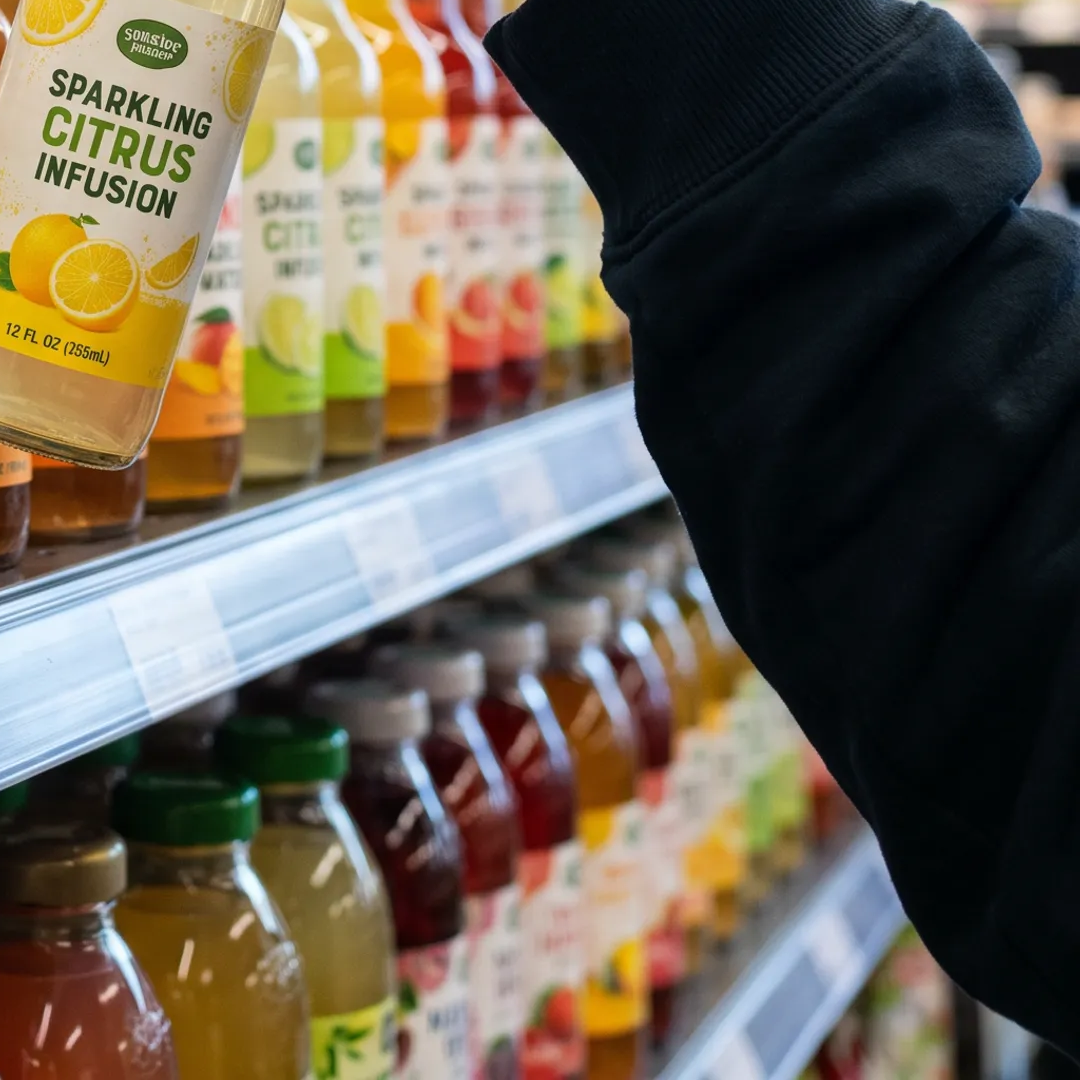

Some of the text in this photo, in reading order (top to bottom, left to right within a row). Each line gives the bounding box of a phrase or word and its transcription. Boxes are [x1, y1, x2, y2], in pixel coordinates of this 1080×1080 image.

[49, 68, 213, 140] SPARKLING
[42, 106, 196, 183] CITRUS
[34, 151, 178, 219] INFUSION
[5, 322, 21, 338] 12
[23, 327, 38, 345] FL
[43, 334, 62, 350] OZ
